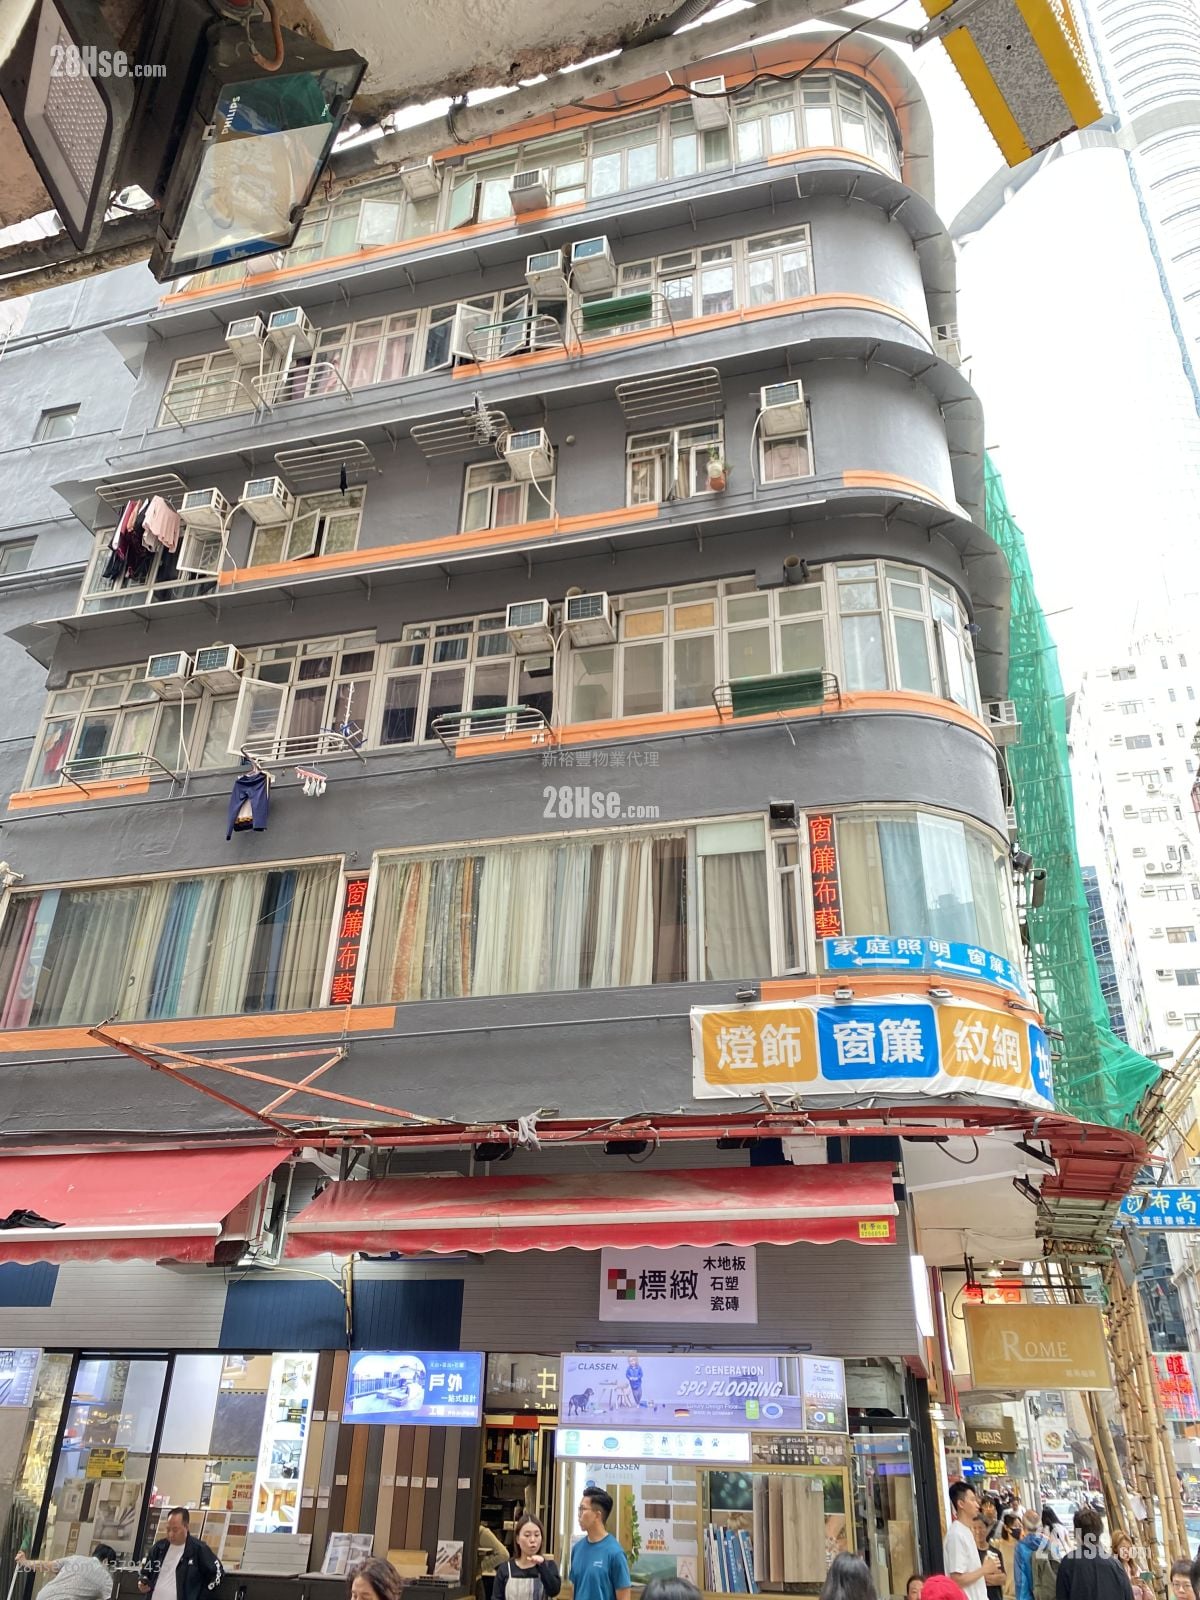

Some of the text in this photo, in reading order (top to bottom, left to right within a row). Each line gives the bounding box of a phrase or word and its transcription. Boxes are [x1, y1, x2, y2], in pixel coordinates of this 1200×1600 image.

[221, 95, 241, 135] PHILIPS
[809, 816, 840, 937] 窗簾布藝
[332, 880, 367, 1003] 窗簾布藝
[833, 938, 950, 958] 家庭照明
[716, 1023, 801, 1070] 燈飾
[832, 1018, 925, 1066] 窗簾
[953, 1019, 1022, 1074] 紋網
[703, 1256, 746, 1271] 木地板
[639, 1269, 699, 1300] 標緻
[710, 1276, 740, 1291] 石塑
[710, 1296, 740, 1312] 瓷磚
[705, 1365, 764, 1375] GENERATION
[429, 1373, 463, 1392] 戶外
[677, 1381, 783, 1397] SPC FLOORING
[603, 1463, 640, 1471] CLASSEN
